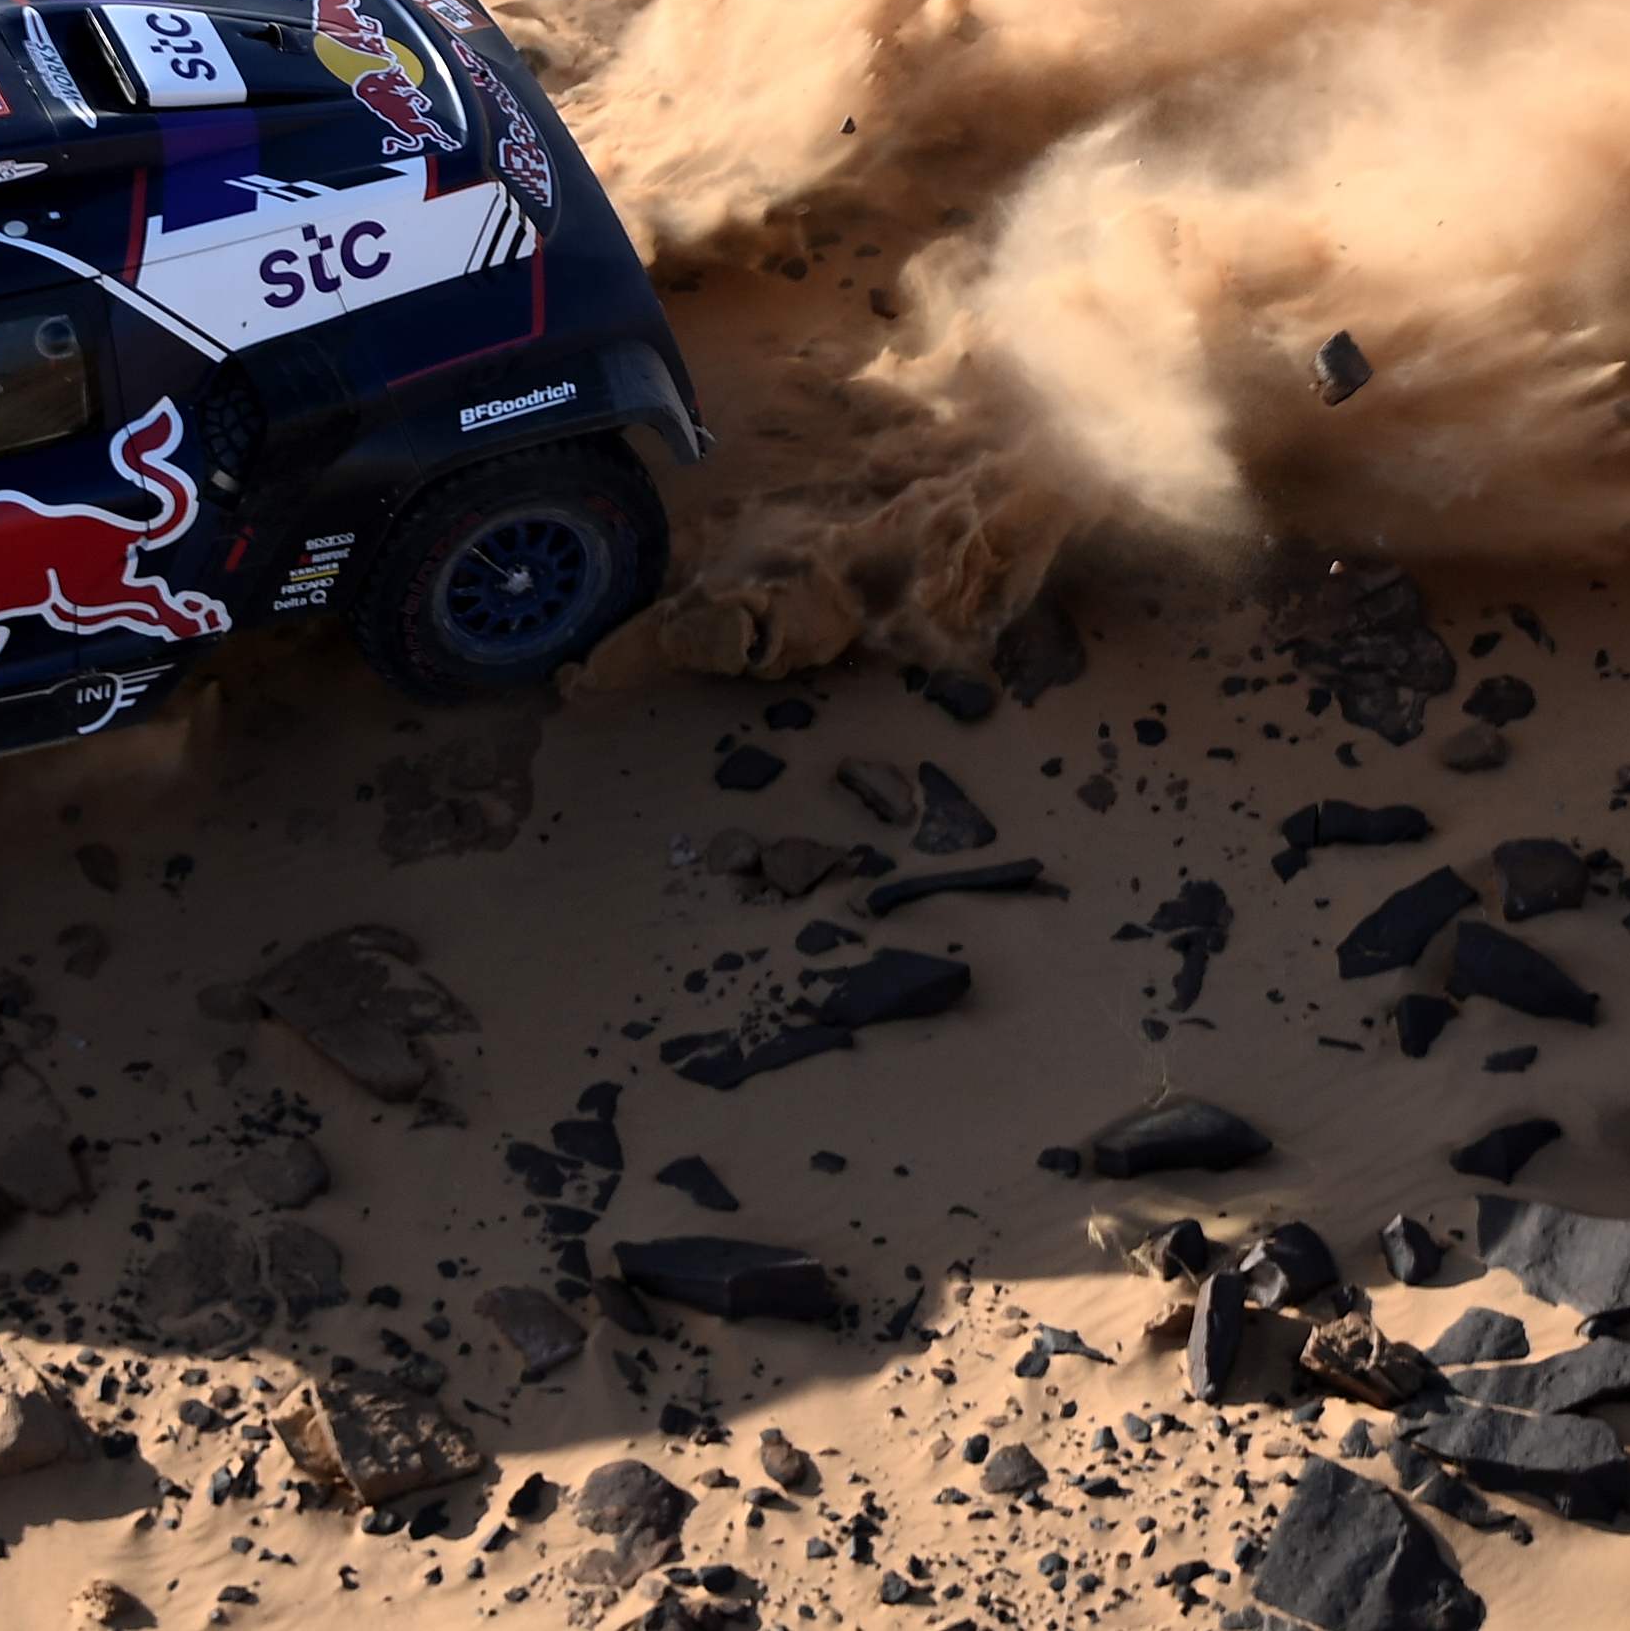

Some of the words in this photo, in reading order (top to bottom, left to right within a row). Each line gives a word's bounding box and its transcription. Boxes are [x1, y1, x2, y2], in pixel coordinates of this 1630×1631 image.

[36, 42, 83, 102] WORKS
[146, 13, 216, 81] stc
[259, 220, 391, 308] stc
[460, 381, 577, 426] BFGoodrich
[273, 597, 308, 611] Delta
[310, 589, 327, 605] Q
[75, 683, 111, 704] INI
